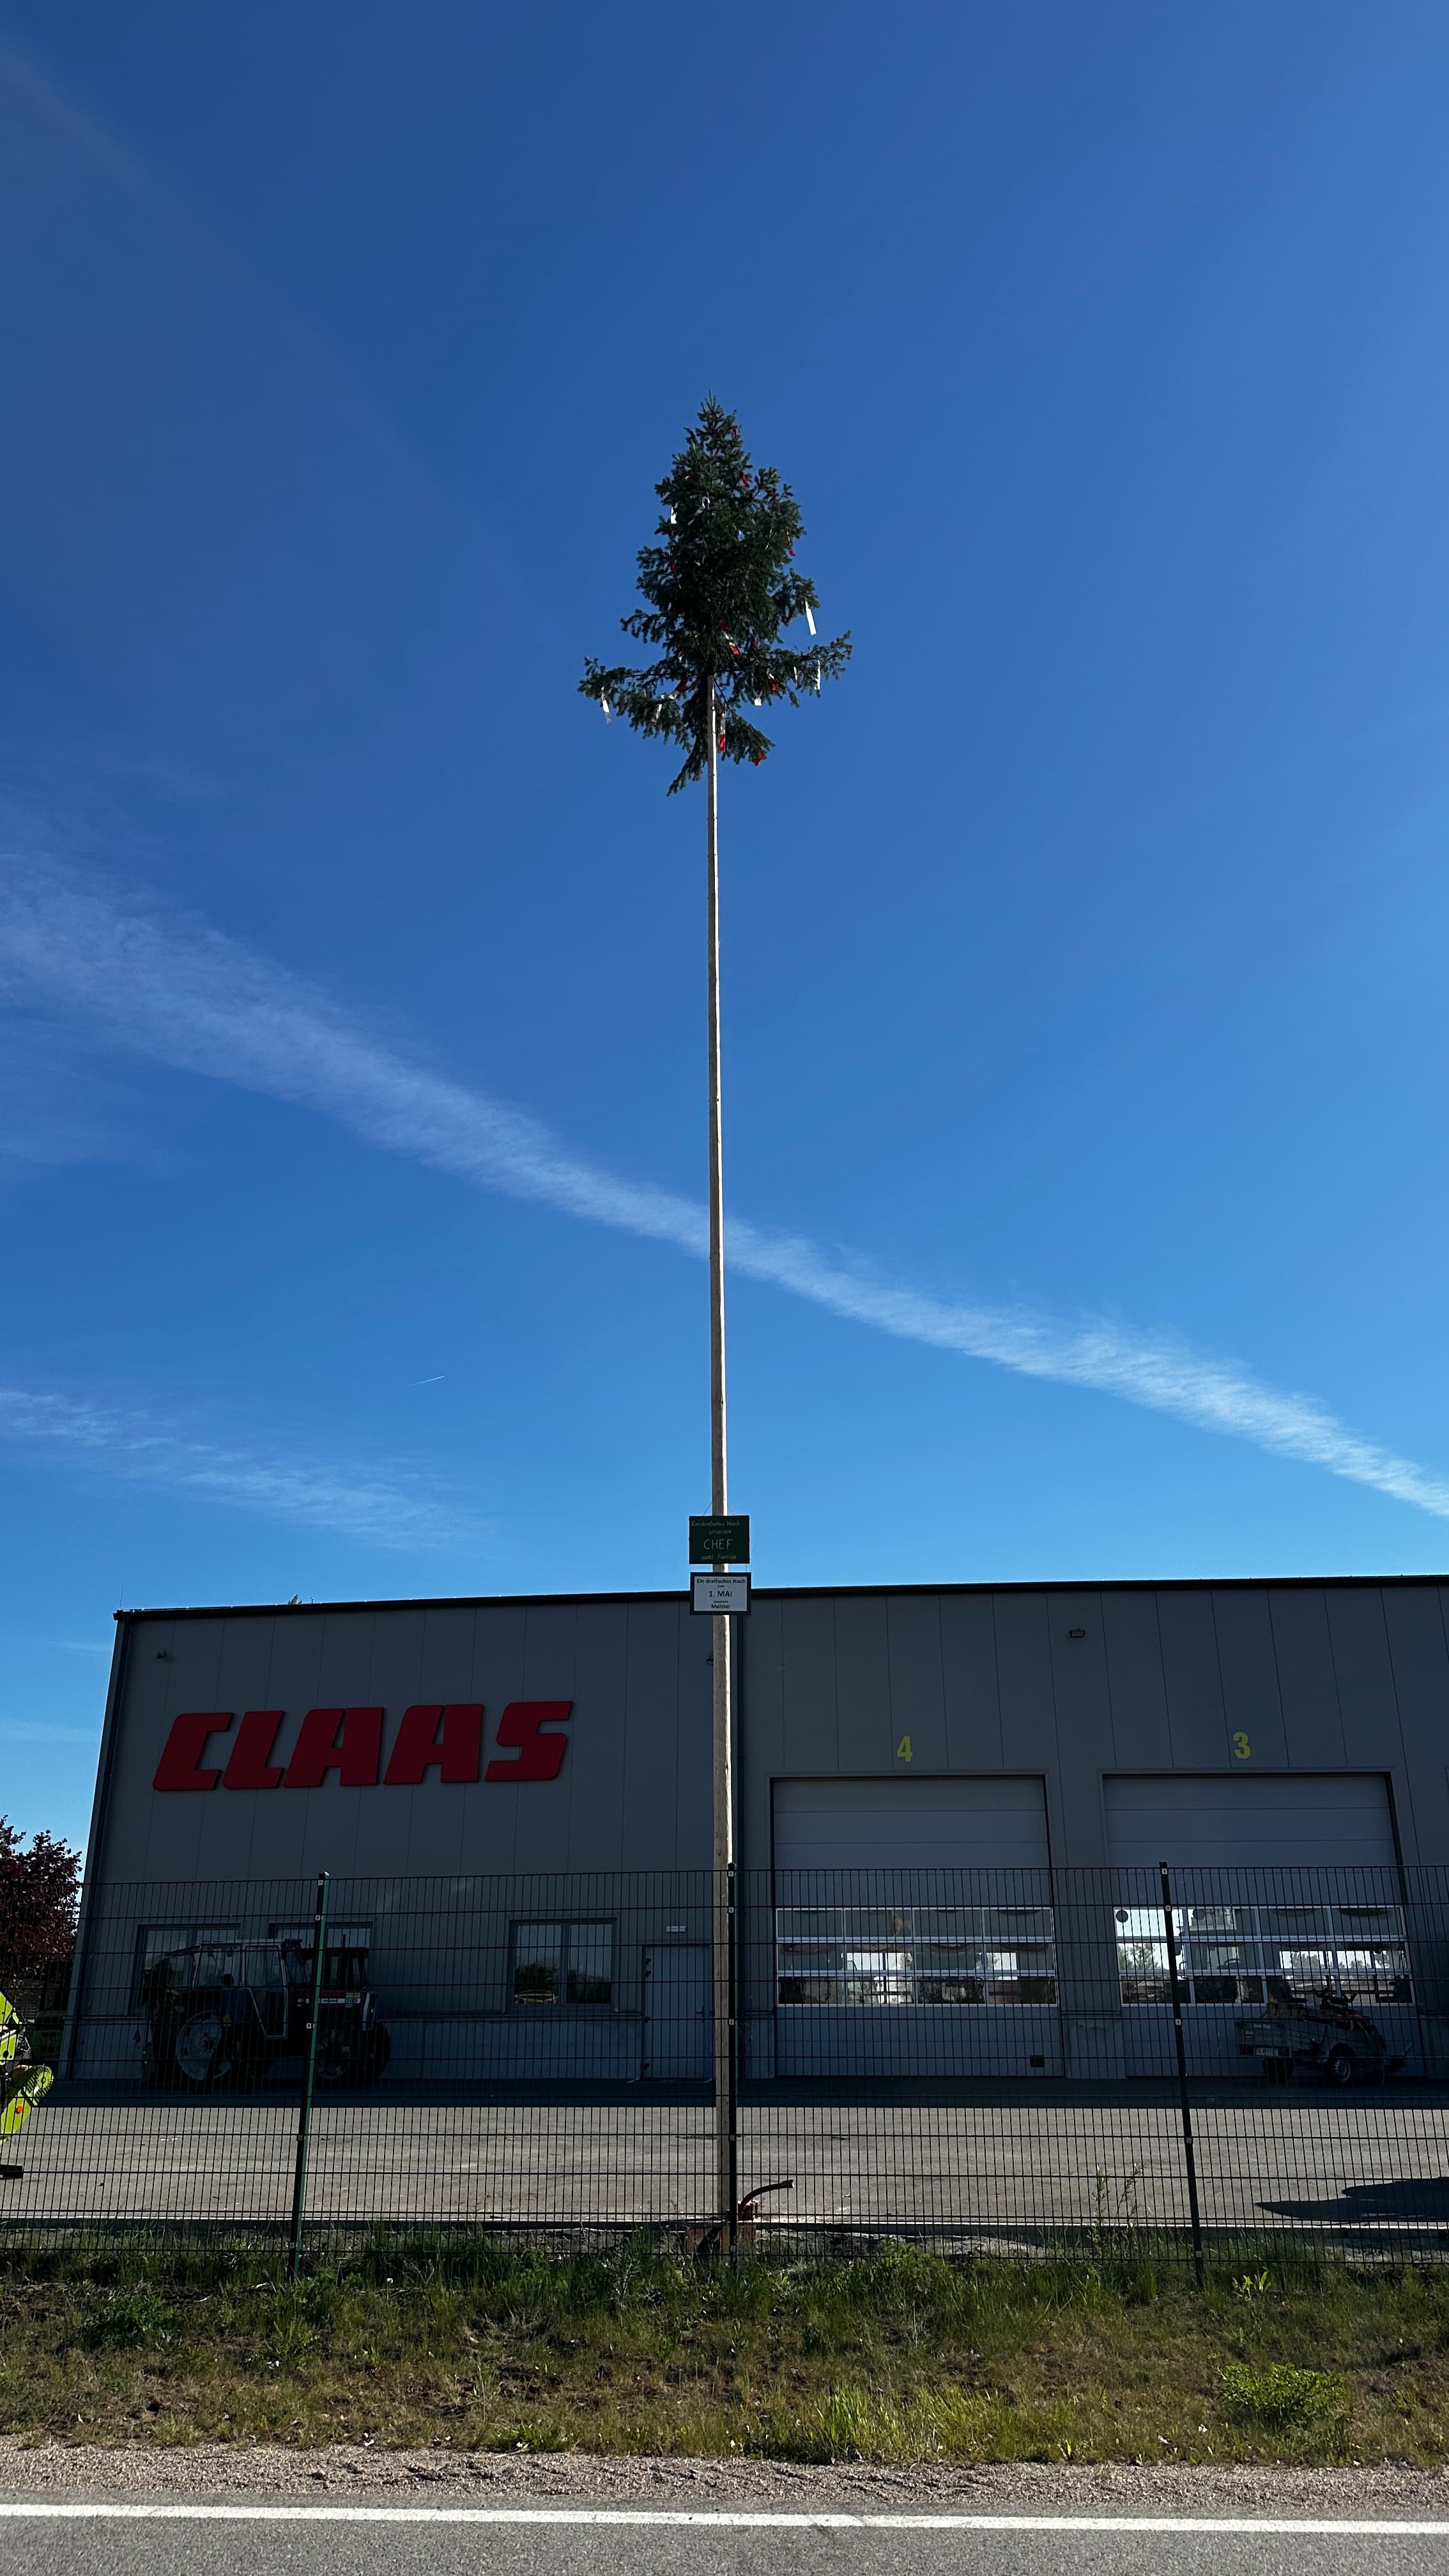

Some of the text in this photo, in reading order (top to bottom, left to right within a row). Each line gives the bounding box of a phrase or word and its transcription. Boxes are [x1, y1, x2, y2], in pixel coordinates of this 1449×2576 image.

[703, 1538, 735, 1550] CHEF
[152, 1701, 573, 1791] CLAAS
[896, 1735, 913, 1763] 4
[1234, 1731, 1251, 1759] 3
